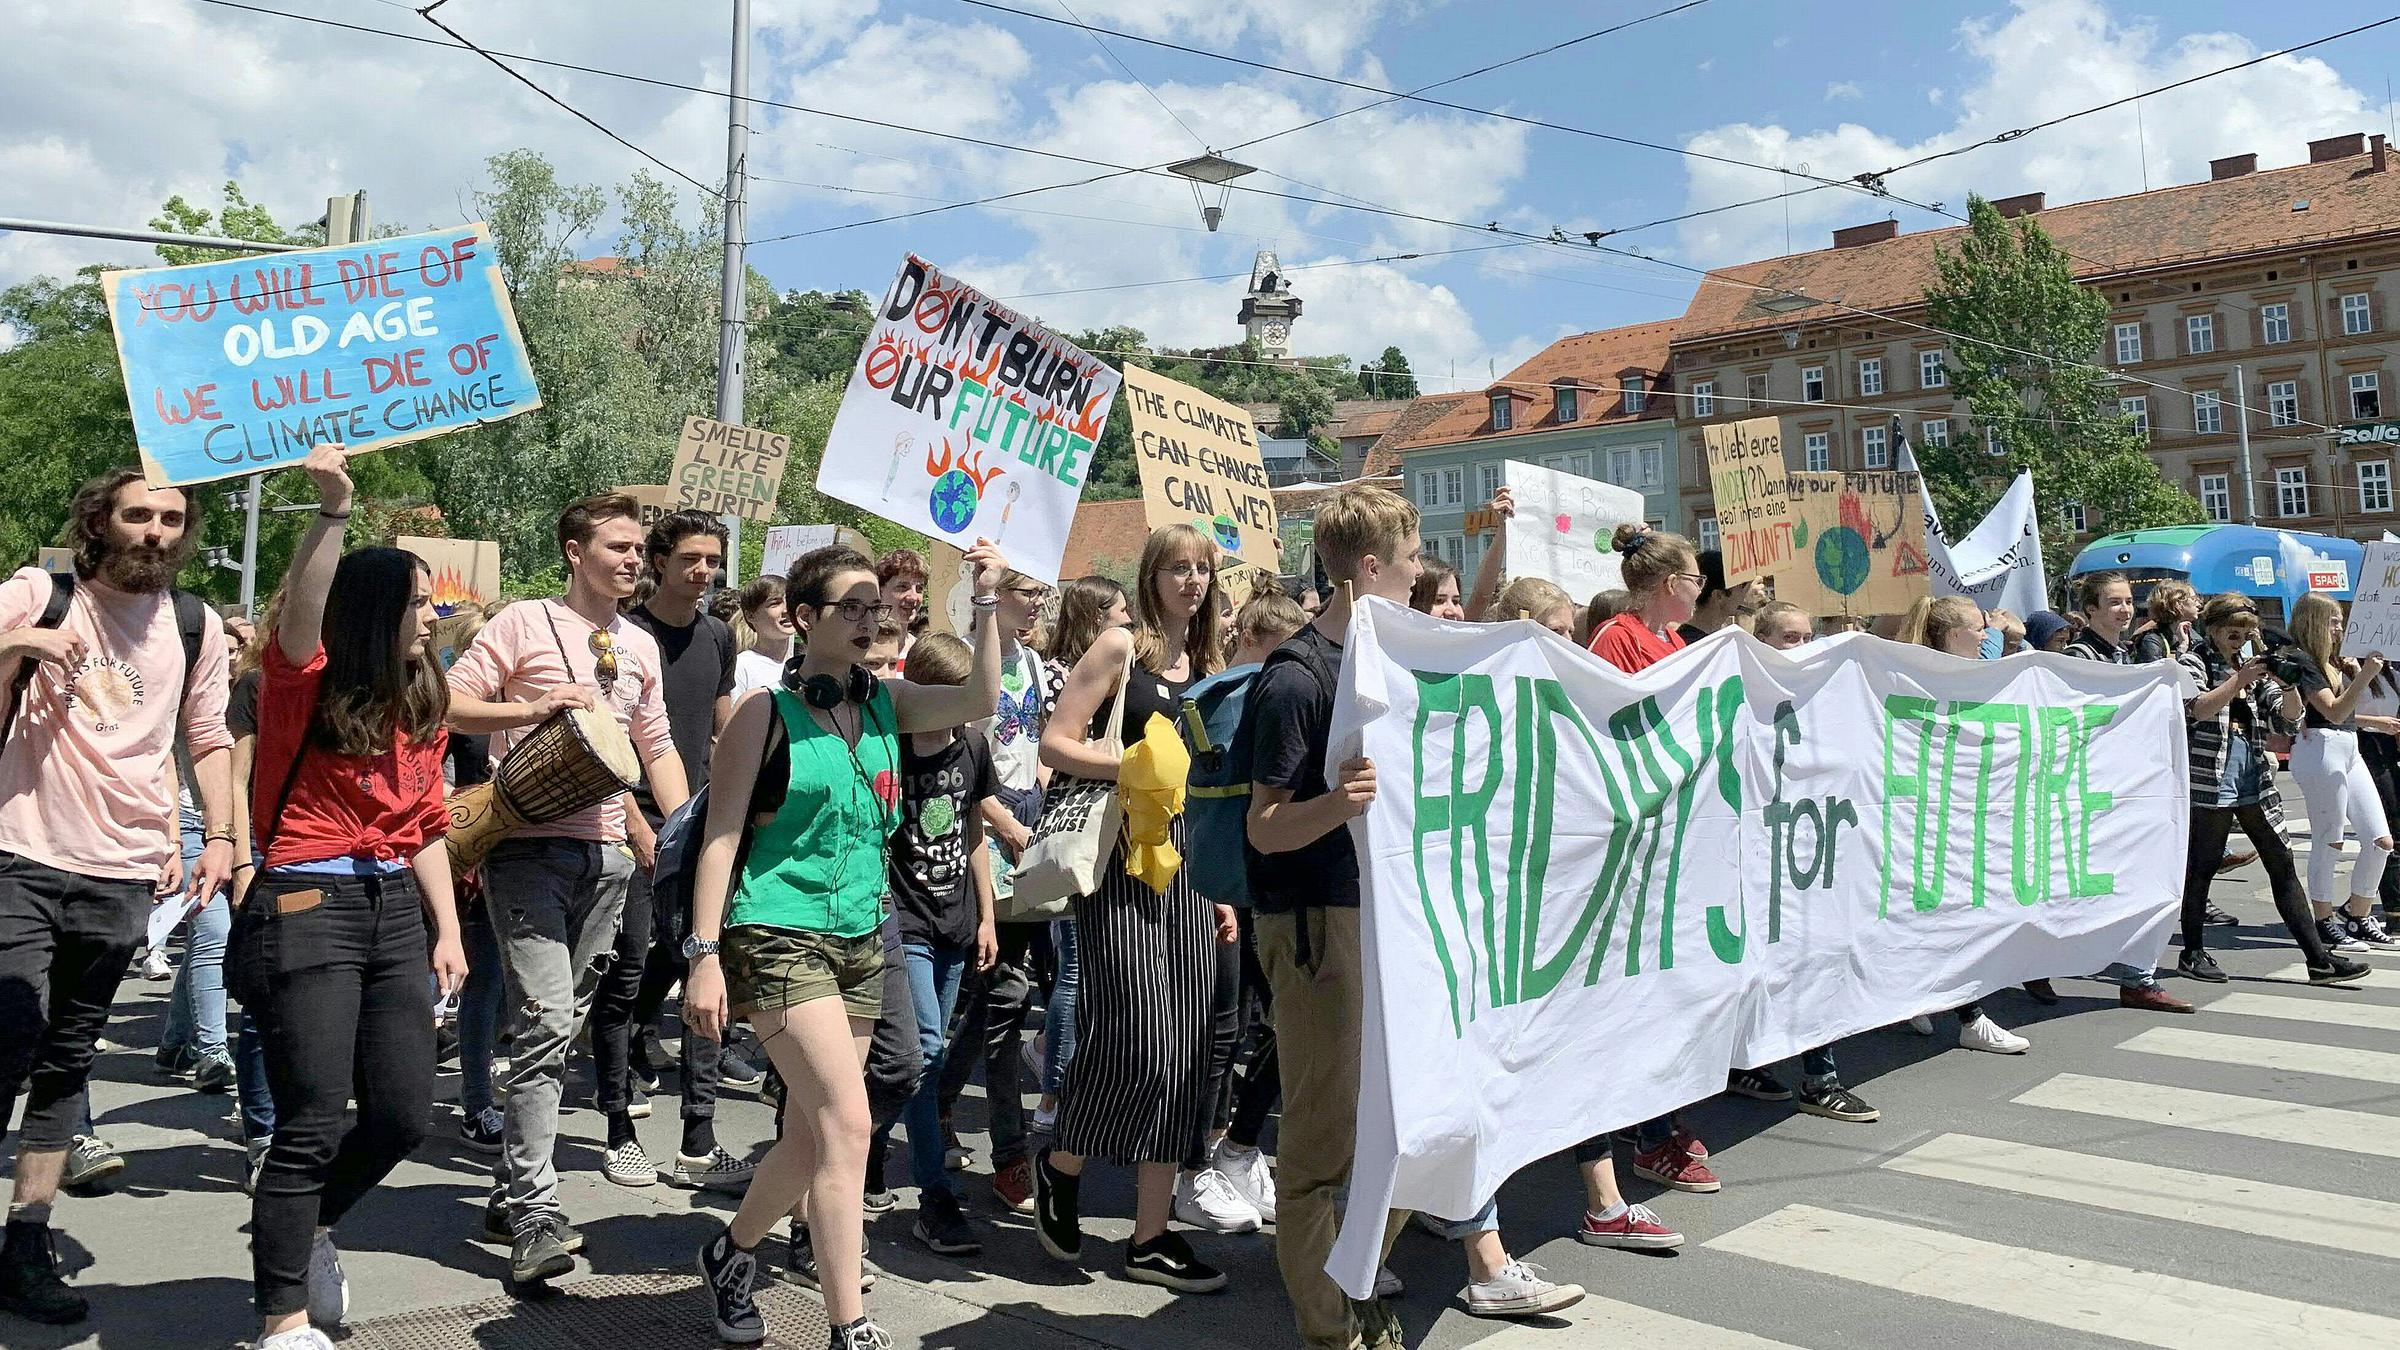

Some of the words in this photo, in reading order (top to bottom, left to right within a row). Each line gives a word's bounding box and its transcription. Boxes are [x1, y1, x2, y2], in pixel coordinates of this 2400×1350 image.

[130, 279, 217, 327] YOU
[230, 264, 325, 316] WILL
[337, 253, 405, 304] DIE
[419, 236, 478, 288] OF
[223, 314, 331, 367] OLD
[338, 296, 440, 349] AGE
[886, 260, 1011, 362] DON'T
[998, 331, 1093, 415] BURN
[155, 383, 222, 425] WE
[252, 368, 351, 412] WILL
[362, 348, 432, 394] DIE
[448, 333, 499, 375] OF
[203, 404, 376, 464] CLIMATE
[382, 373, 515, 431] CHANGE
[687, 419, 787, 458] SMELLS
[865, 343, 953, 421] OUR
[949, 379, 1096, 487] FUTURE
[1129, 384, 1168, 419] THE
[1174, 399, 1252, 447] CLIMATE
[693, 444, 772, 476] LIKE
[1141, 430, 1190, 467] CAN
[1199, 447, 1268, 489] CHANGE
[1750, 434, 1780, 458] eure
[678, 485, 764, 521] SPIRIT
[679, 462, 775, 502] GREEN
[1164, 476, 1215, 516] CAN
[1226, 487, 1273, 533] WE?
[1517, 471, 1568, 509] Keine
[1756, 464, 1786, 499] Dann
[1765, 497, 1787, 517] eine
[1843, 471, 1921, 494] FUTURE
[1727, 522, 1792, 576] ZUKUNFT
[2315, 575, 2339, 586] SPAR
[2346, 621, 2400, 647] PLAN
[93, 656, 117, 669] FOR
[118, 662, 145, 707] FUTURE
[1411, 668, 1747, 1040] FRIDAYS
[1764, 699, 1859, 944] for
[1879, 694, 2120, 920] FUTURE
